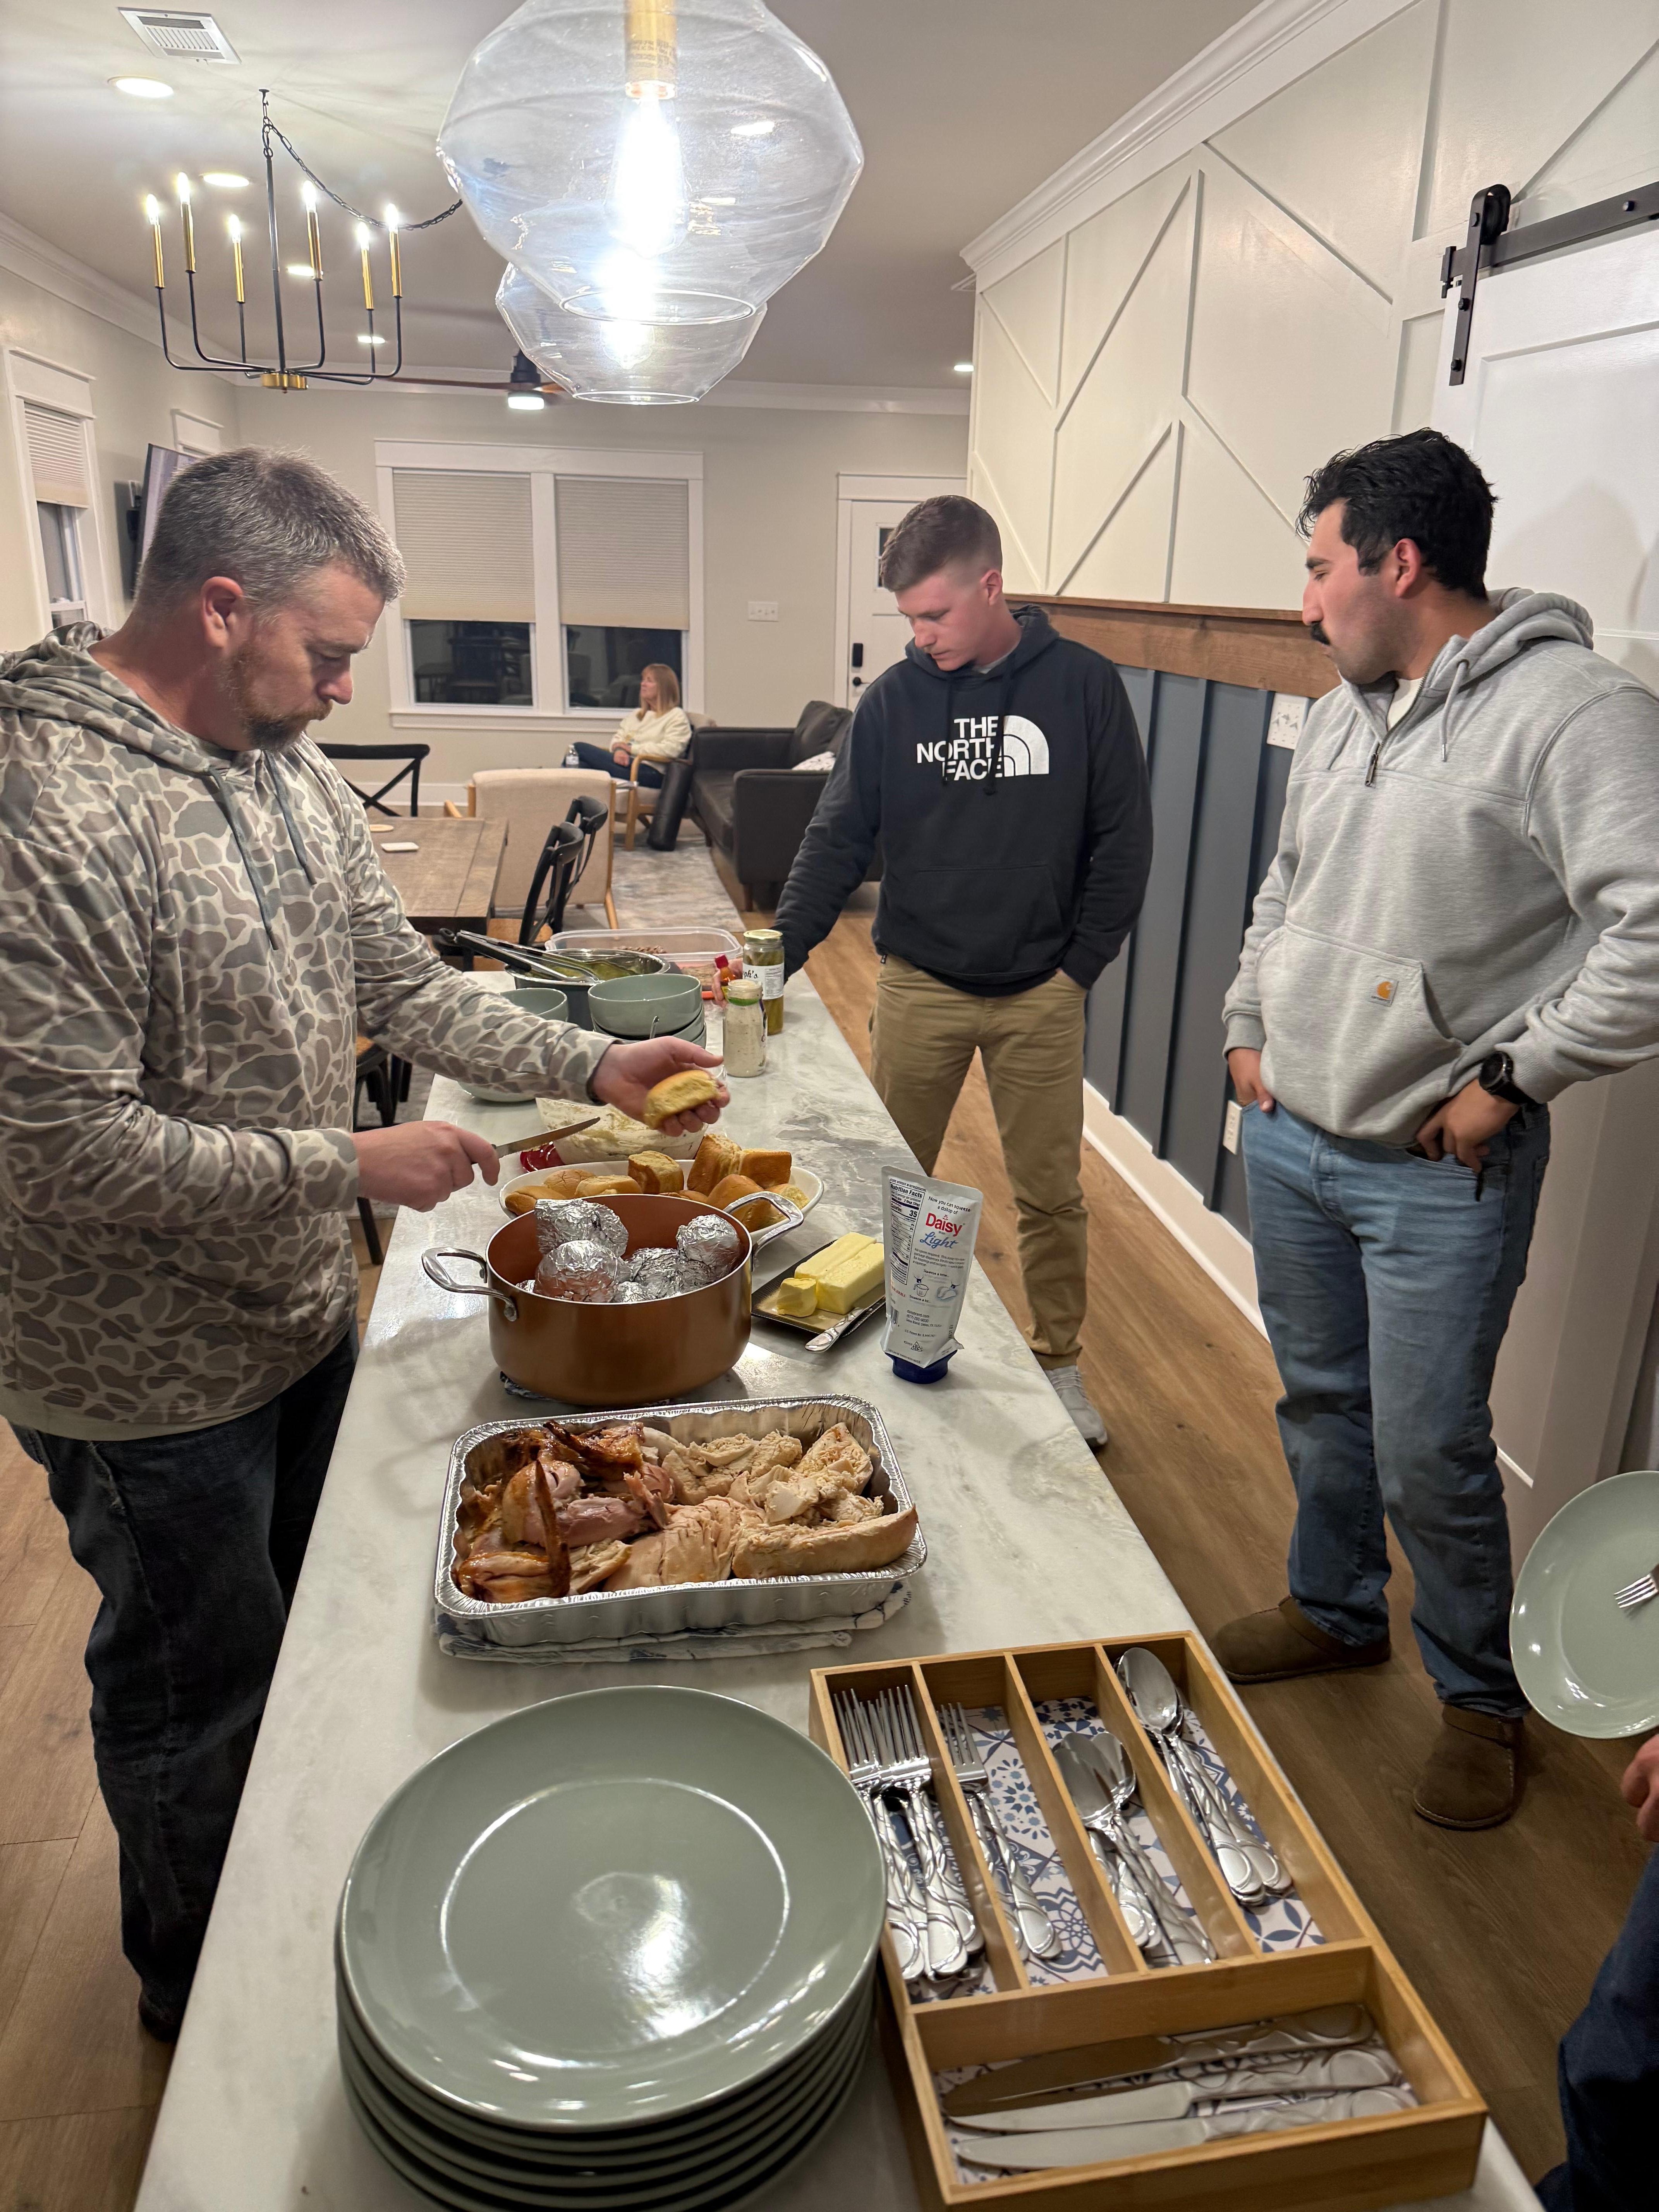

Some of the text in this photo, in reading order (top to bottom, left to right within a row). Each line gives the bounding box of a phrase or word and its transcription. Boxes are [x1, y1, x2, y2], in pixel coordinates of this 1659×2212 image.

[954, 716, 999, 738] THE
[925, 1212, 963, 1237] Daisy
[920, 1231, 959, 1249] Light
